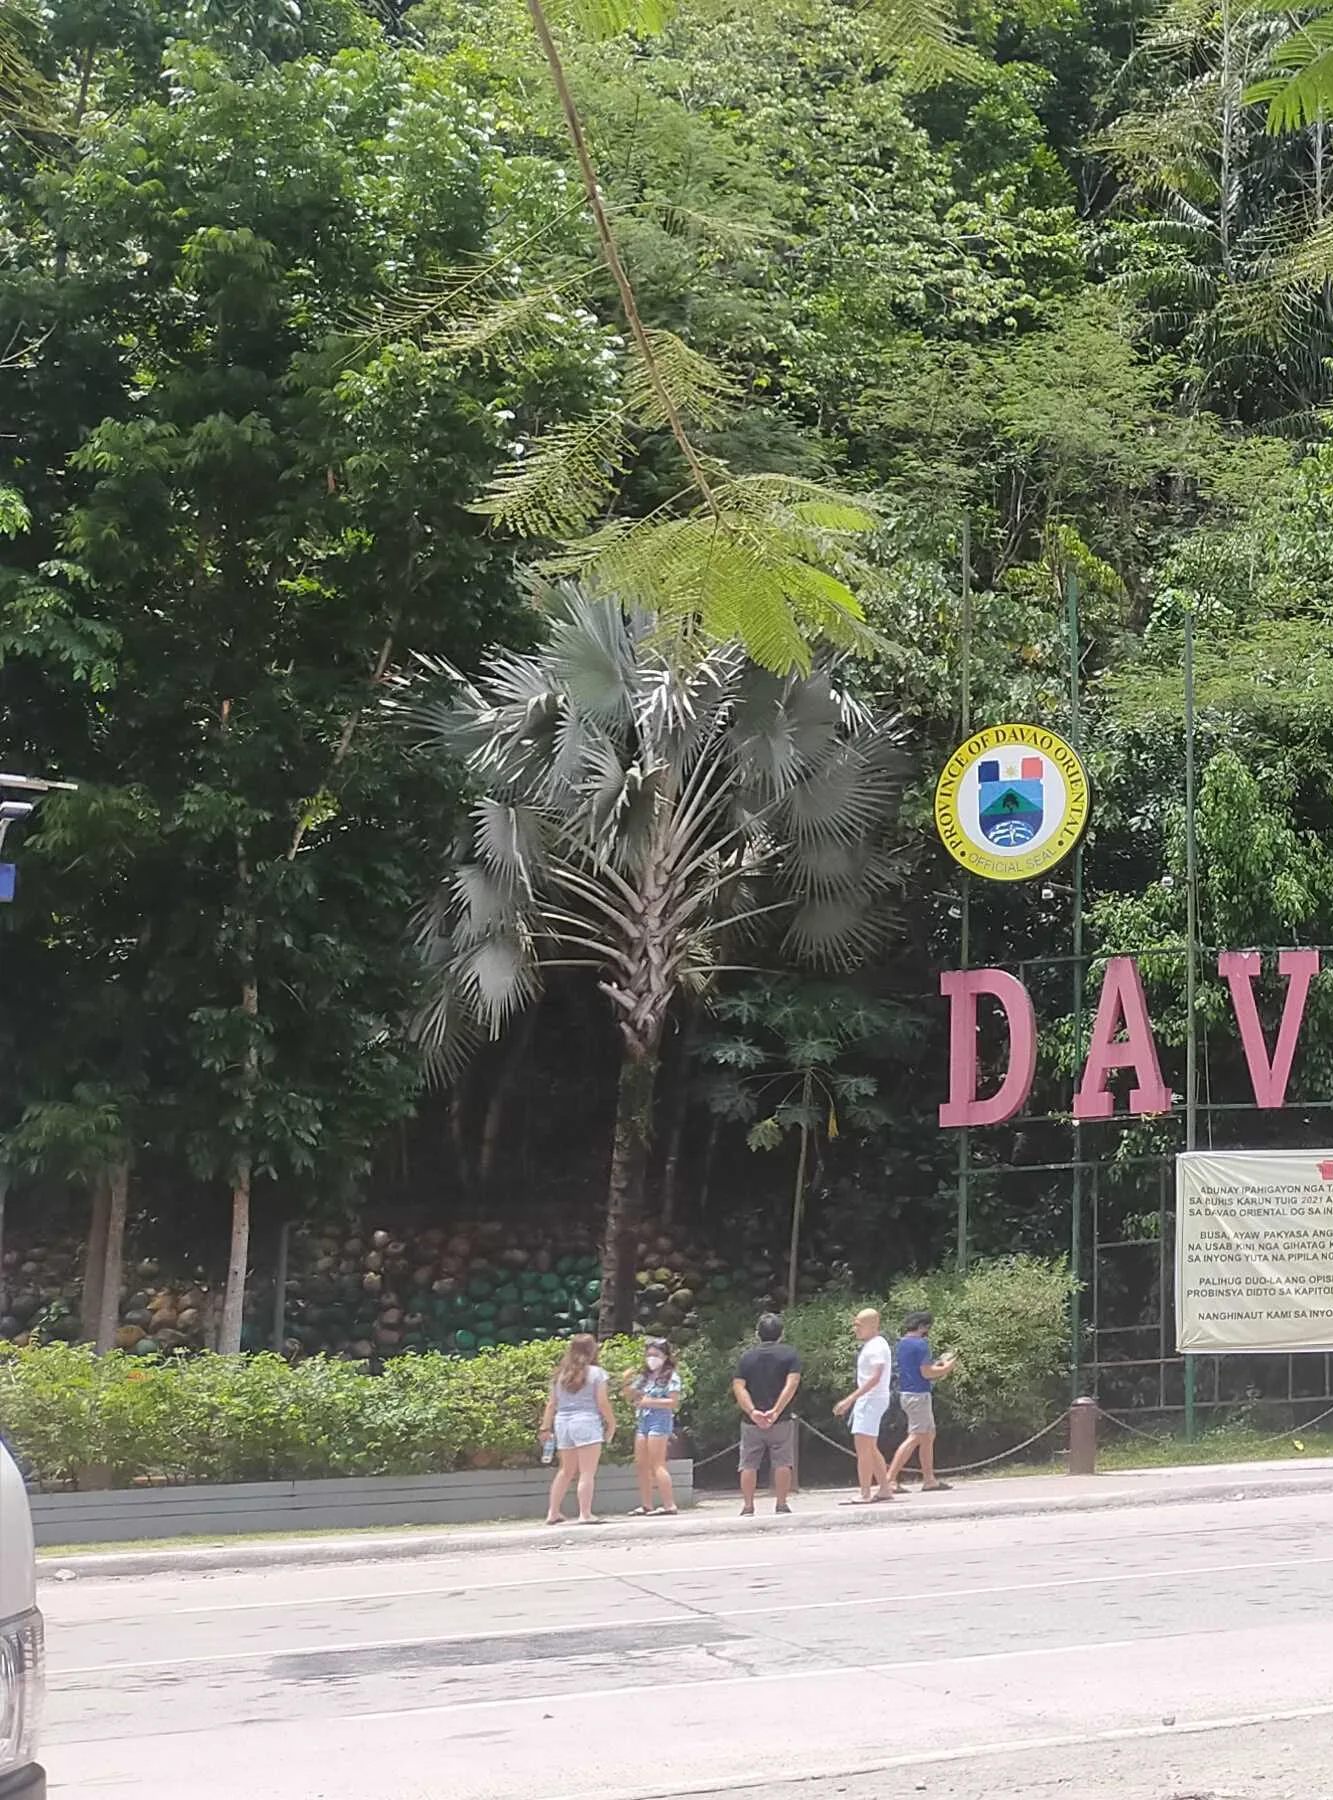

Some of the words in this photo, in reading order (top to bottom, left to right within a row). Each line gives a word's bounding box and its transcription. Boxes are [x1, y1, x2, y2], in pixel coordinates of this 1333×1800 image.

[938, 755, 969, 851] PROVINCE
[967, 733, 990, 755] OF
[995, 727, 1053, 750] DAVAO
[1054, 746, 1085, 838] ORIENTAL
[968, 852, 1024, 872] OFFICIAL
[1026, 848, 1057, 868] SEAL
[1200, 1186, 1238, 1194] ADUNAY
[1242, 1185, 1301, 1194] IPAHIGAYON
[1304, 1185, 1323, 1193] NGA
[1189, 1197, 1201, 1205] SA
[1237, 1197, 1271, 1206] KARUN
[1275, 1196, 1298, 1205] TUIG
[1189, 1208, 1201, 1216] SA
[1239, 1207, 1288, 1216] ORIENTAL
[1290, 1207, 1305, 1216] OG
[1308, 1206, 1321, 1215] SA
[1233, 1231, 1260, 1239] AYAW
[1264, 1230, 1309, 1239] PAKYASA
[1312, 1229, 1333, 1238] ANG
[1188, 1243, 1201, 1251] NA
[1205, 1242, 1232, 1250] USAB
[1258, 1242, 1279, 1250] NGA
[1283, 1240, 1326, 1250] GIHATAG
[1188, 1254, 1201, 1263] SA
[1203, 1253, 1241, 1263] INYONG
[1244, 1253, 1269, 1262] YUTA
[1272, 1253, 1286, 1262] NA
[1288, 1252, 1319, 1261] PIPILA
[1200, 1277, 1241, 1286] PALIHUG
[1284, 1276, 1306, 1285] ANG
[1187, 1288, 1243, 1298] PROBINSYA
[1246, 1288, 1276, 1297] DIDTO
[1279, 1287, 1292, 1296] SA
[1198, 1311, 1263, 1320] NANGHINAUT
[1266, 1311, 1291, 1319] KAMI
[1294, 1310, 1306, 1318] SA
